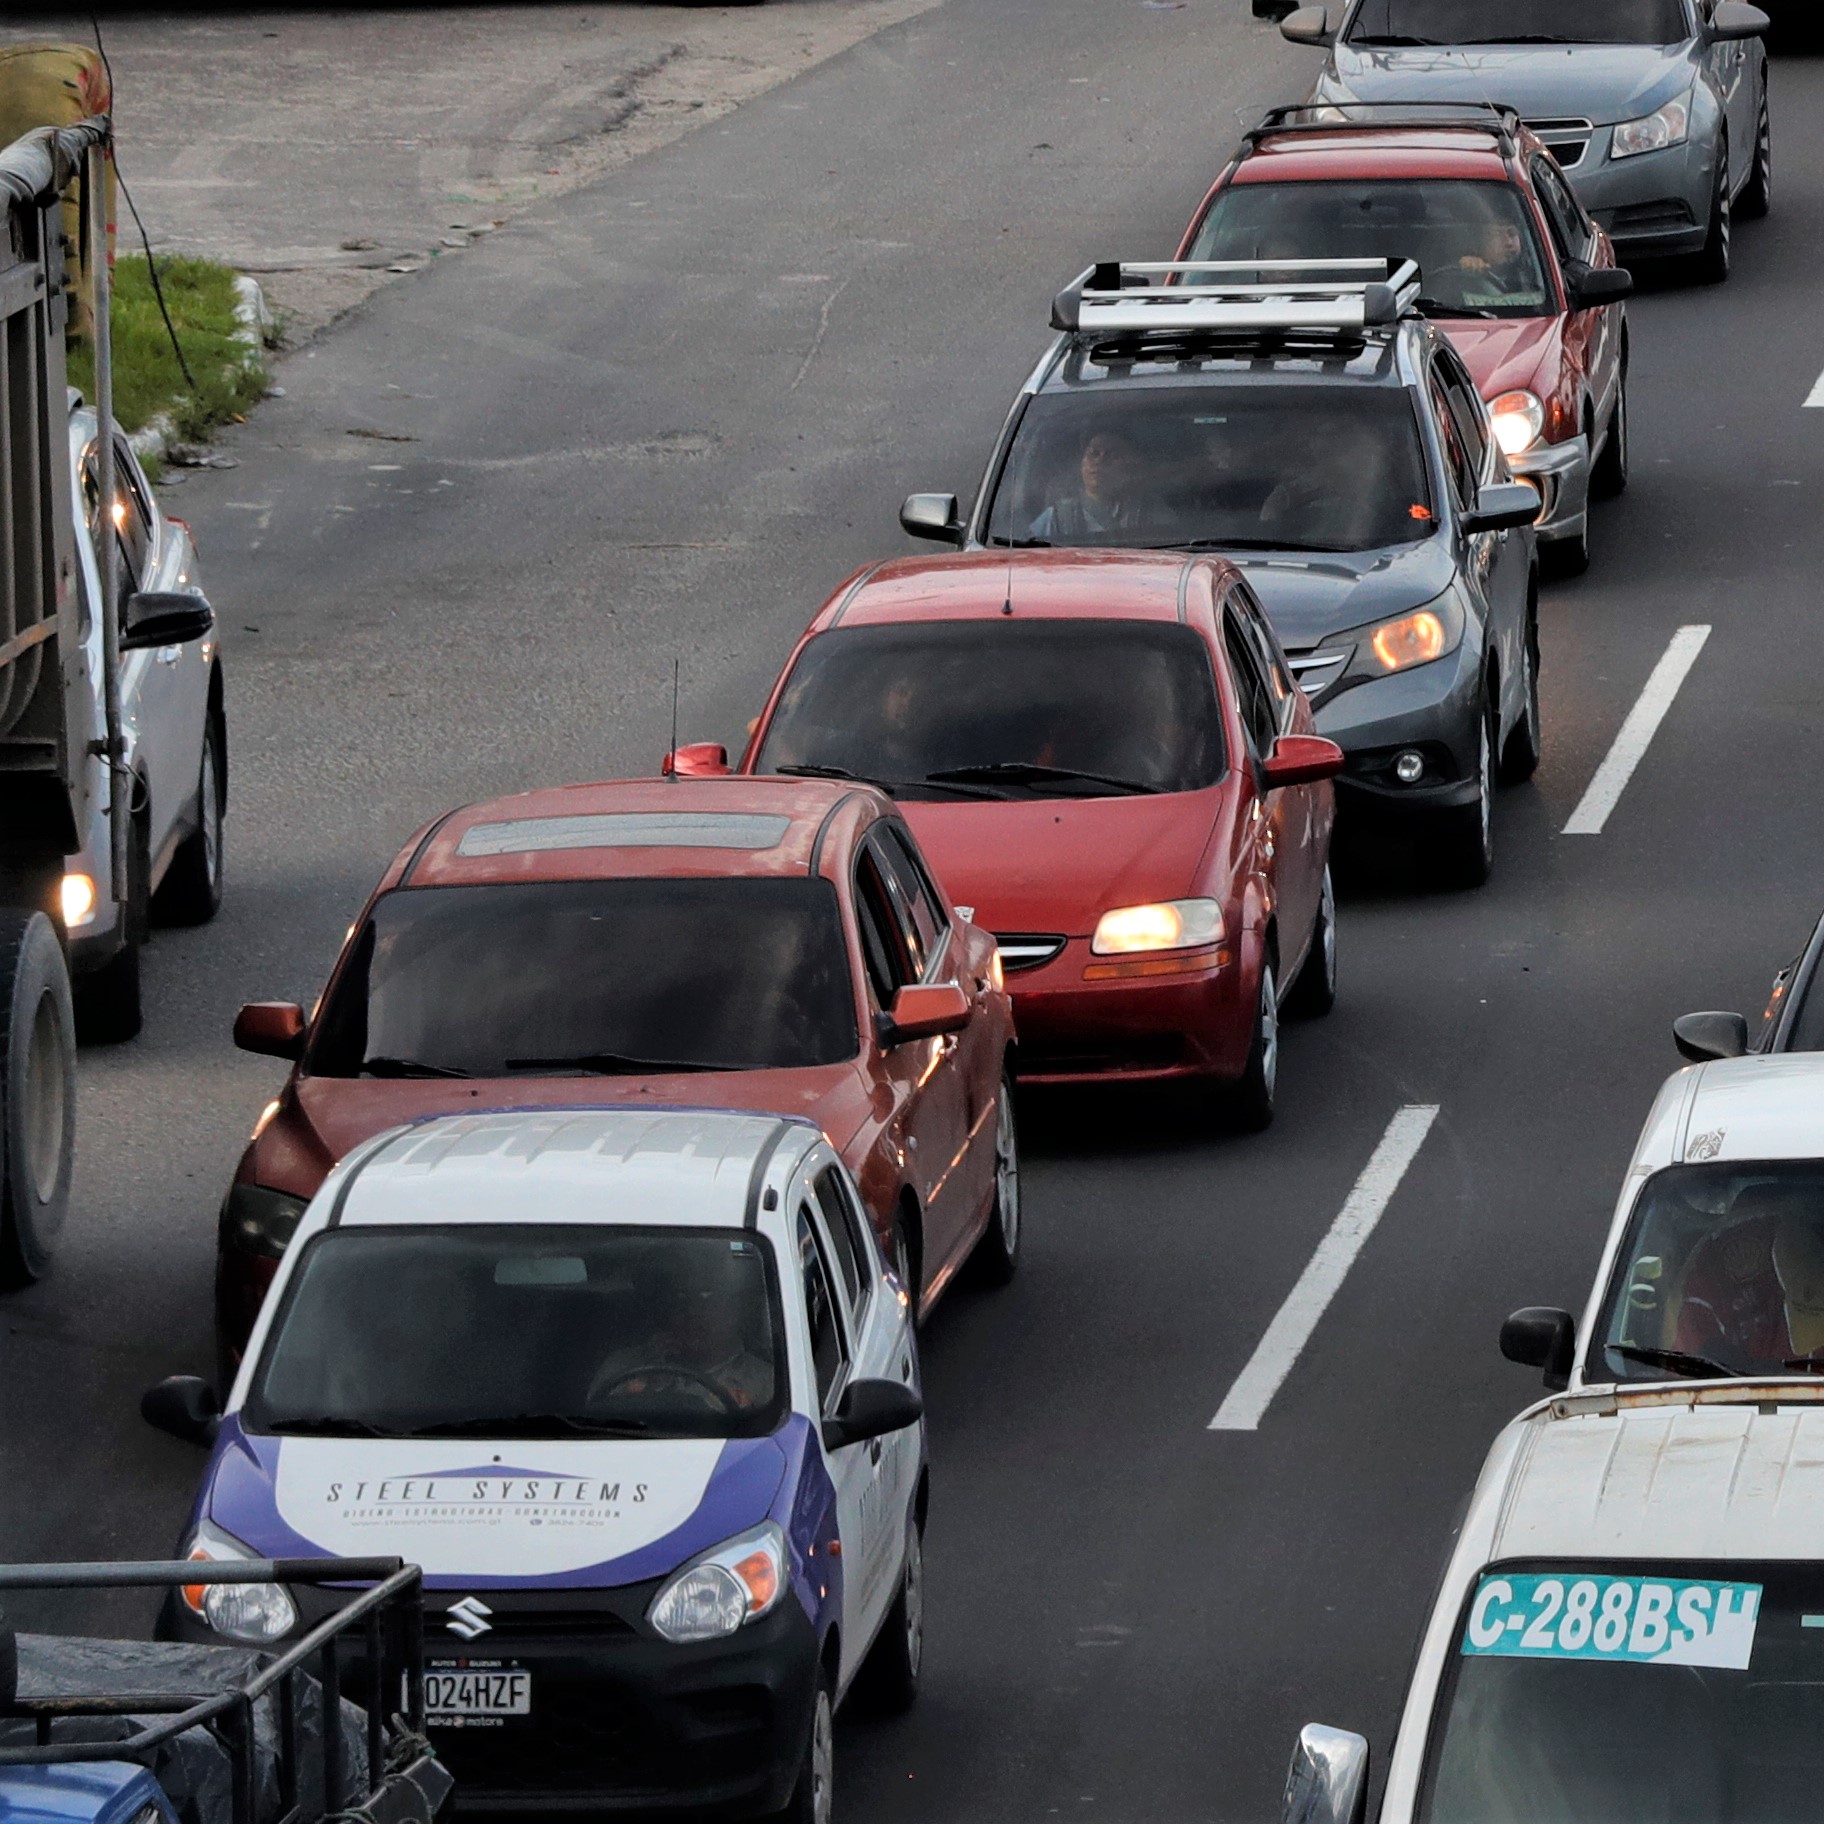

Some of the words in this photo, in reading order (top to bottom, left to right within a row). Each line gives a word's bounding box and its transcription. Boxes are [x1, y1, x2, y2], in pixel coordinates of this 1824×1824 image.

[327, 1481, 437, 1503] STEEL
[472, 1480, 648, 1503] SYSTEMS
[1468, 1579, 1759, 1654] C-288BSH
